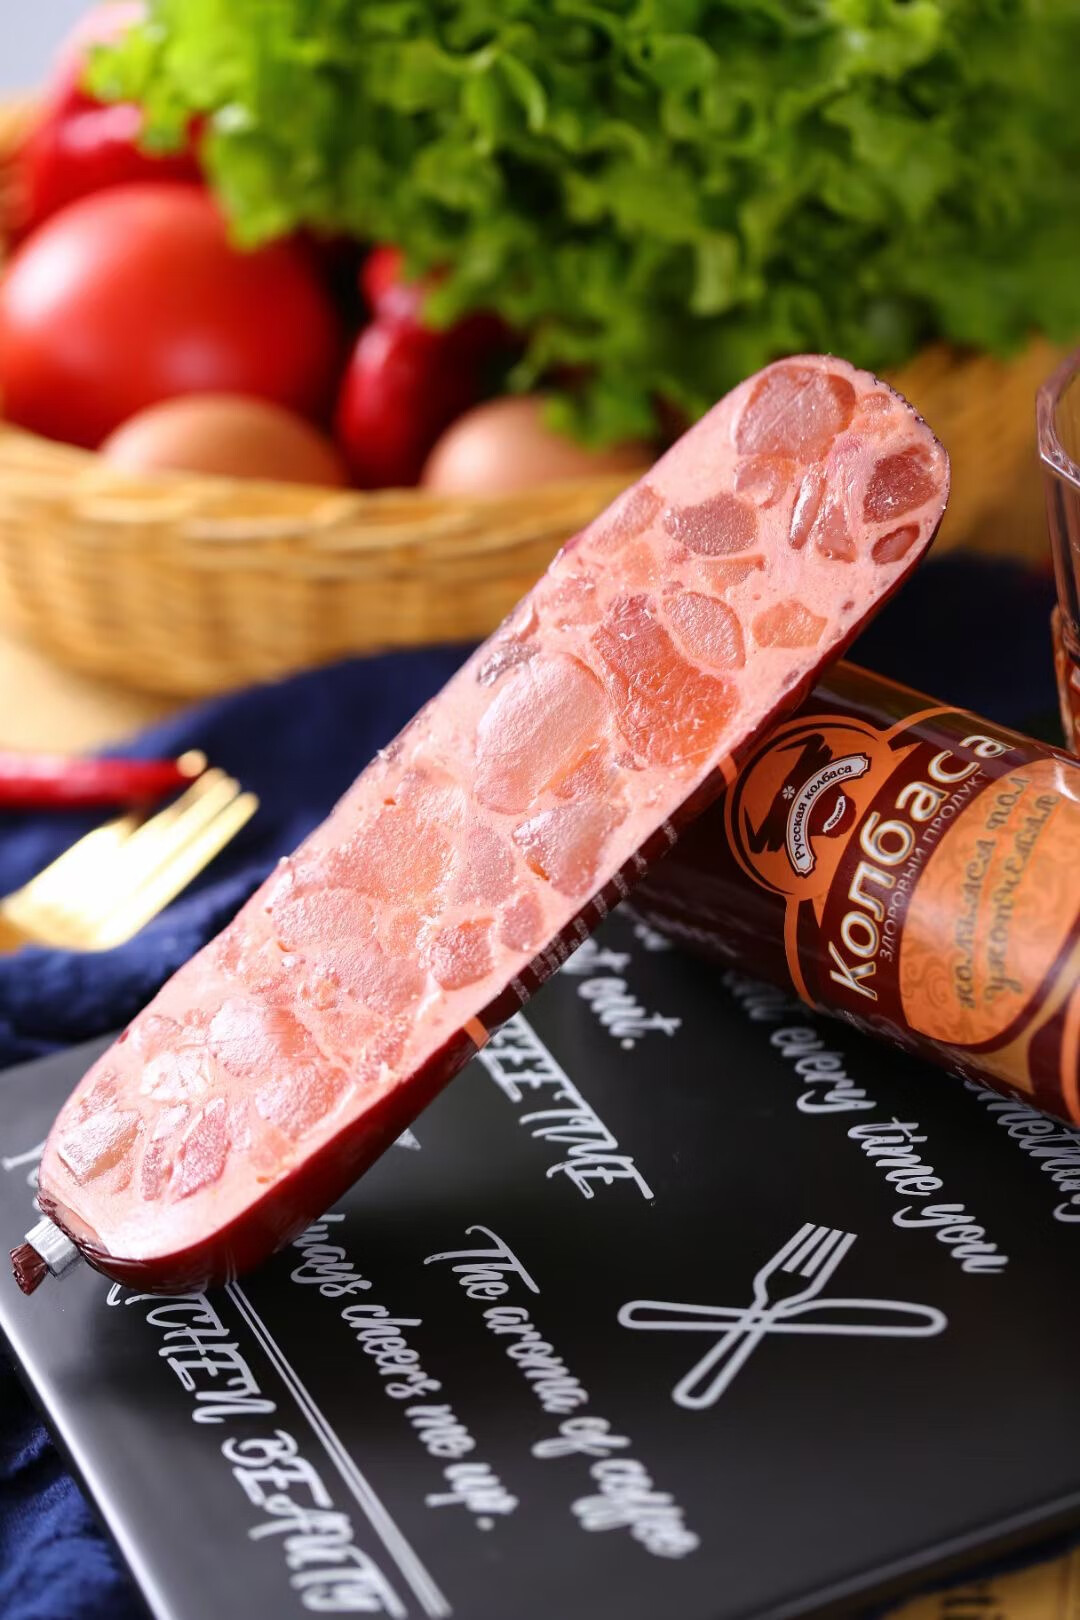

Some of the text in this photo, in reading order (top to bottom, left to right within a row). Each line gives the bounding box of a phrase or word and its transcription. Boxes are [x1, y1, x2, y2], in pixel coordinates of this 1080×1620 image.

[793, 802, 807, 860] Русская
[804, 765, 852, 801] колбаса
[922, 769, 989, 844] ПРОДУКТ
[828, 735, 1016, 1001] Колбаса
[770, 1027, 1008, 1273] every time you
[423, 1225, 540, 1300] The
[341, 1304, 442, 1399] cheers
[405, 1404, 475, 1458] me
[482, 1306, 589, 1414] aroma
[531, 1416, 631, 1459] of
[221, 1429, 408, 1620] BEAUTY
